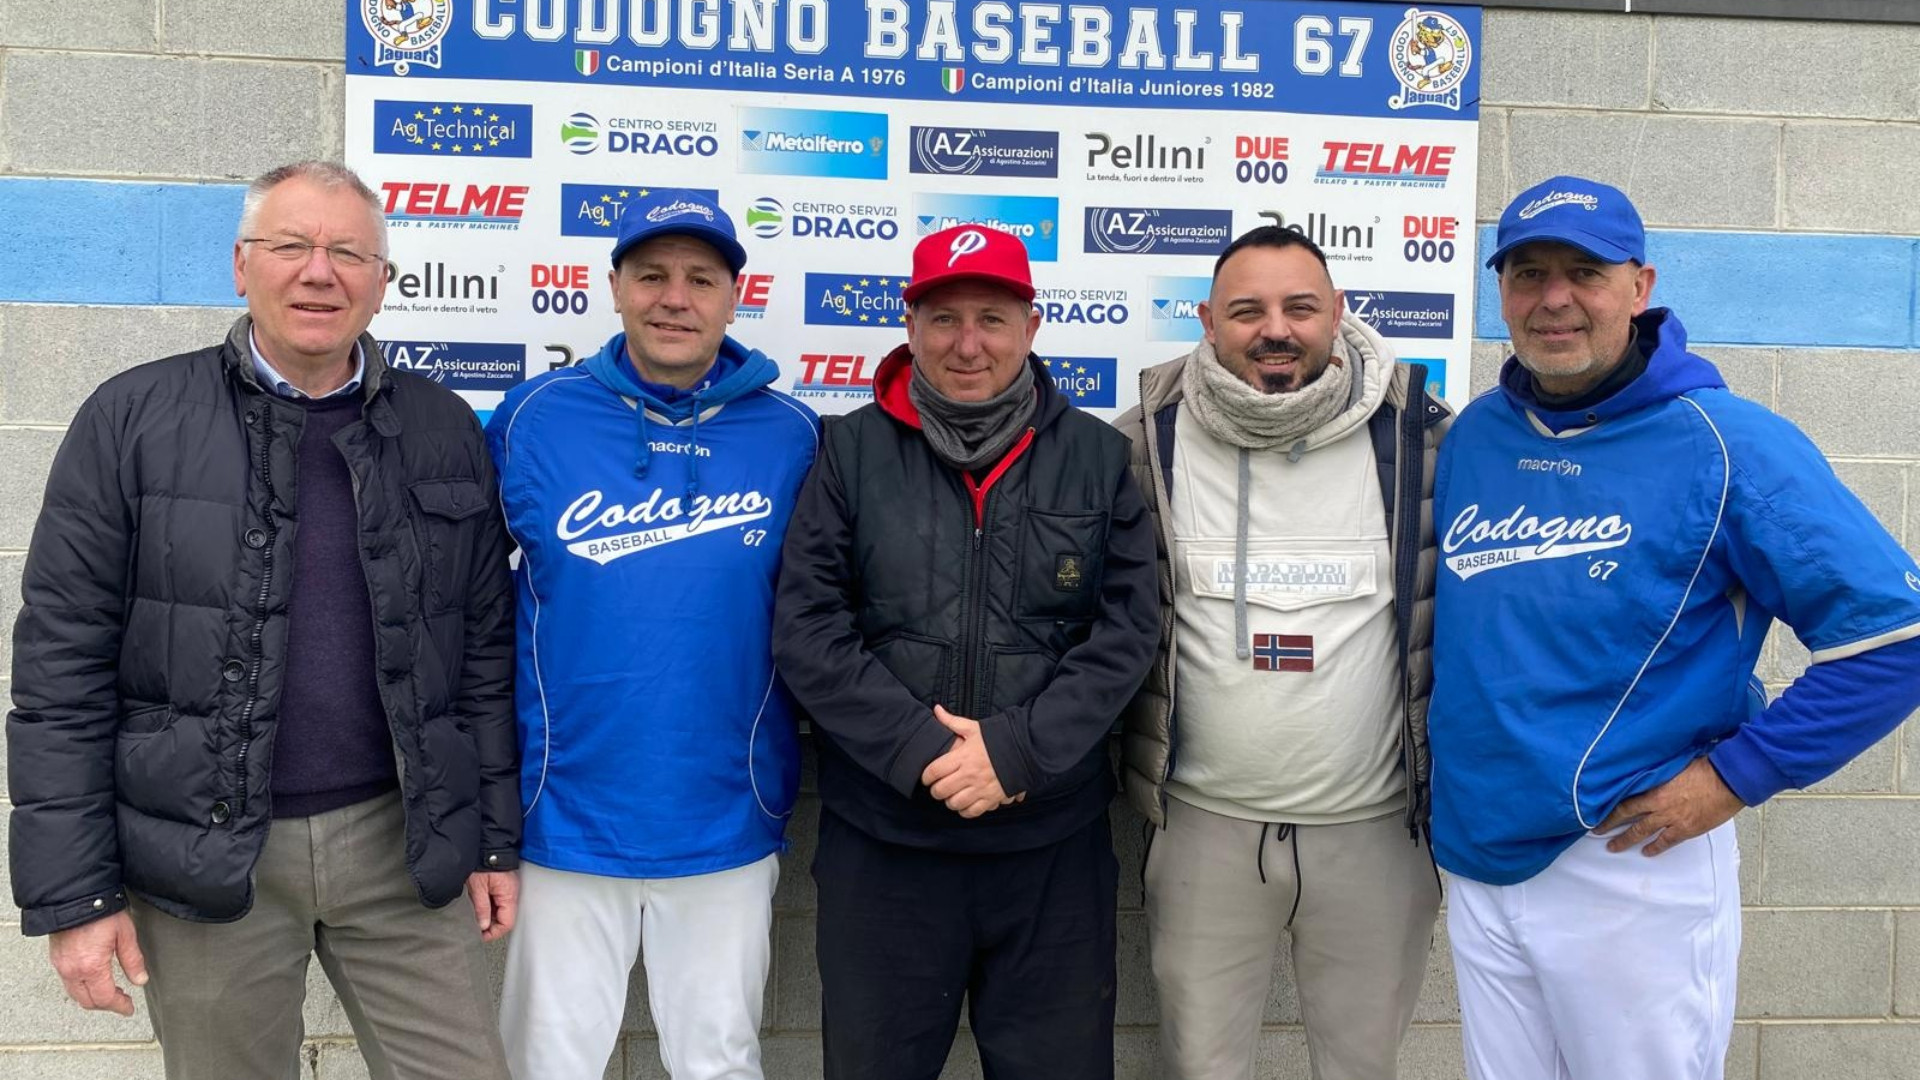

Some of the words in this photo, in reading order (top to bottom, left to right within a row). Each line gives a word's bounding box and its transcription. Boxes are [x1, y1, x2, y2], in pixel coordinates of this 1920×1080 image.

[368, 0, 391, 38] DOGNO
[472, 0, 829, 55] CODOGNO
[863, 0, 1260, 73] BASEBALL
[1293, 15, 1373, 77] 67
[1395, 30, 1416, 82] CODOGNO
[1432, 47, 1466, 89] BASEBALL
[606, 55, 703, 78] Campioni
[709, 60, 777, 79] d'Italia
[783, 63, 835, 82] Seria
[840, 66, 855, 83] A
[861, 67, 906, 86] 1976
[971, 72, 1063, 95] Campioni
[1069, 77, 1134, 96] d'Italia
[1139, 79, 1224, 98] Juniores
[1231, 81, 1275, 99] 1982
[391, 117, 418, 141] Ag
[424, 119, 515, 141] Technical
[608, 118, 663, 131] CENTRO
[666, 120, 717, 133] SERVIZI
[608, 131, 719, 157] DRAGO
[766, 132, 864, 154] Metalferro
[932, 132, 972, 156] AZ
[972, 145, 1053, 159] Assicurazioni
[1085, 133, 1204, 170] Pellini
[1235, 136, 1289, 160] DUE
[1322, 141, 1456, 176] TELME
[1086, 173, 1096, 181] La
[1123, 173, 1142, 182] fuori
[1150, 174, 1176, 183] dentro
[1177, 174, 1183, 183] il
[1184, 175, 1204, 183] vetro
[1313, 178, 1347, 186] GELATO
[1364, 179, 1397, 188] PASTRY
[1399, 180, 1446, 189] MACHINES
[381, 182, 530, 217] TELME
[578, 200, 605, 223] Ag
[792, 202, 846, 214] CENTRO
[849, 204, 897, 217] SERVIZI
[428, 222, 465, 230] PASTRY
[468, 223, 519, 231] MACHINES
[792, 216, 898, 241] DRAGO
[1106, 212, 1146, 235] AZ
[1146, 224, 1227, 237] Assicurazioni
[1403, 216, 1456, 239] DUE
[531, 264, 589, 289] DUE
[821, 289, 846, 314] Ag
[851, 290, 907, 310] Techn
[1034, 288, 1077, 300] ENTRO
[1080, 289, 1128, 301] SERVIZI
[412, 303, 432, 312] fuori
[440, 304, 468, 313] dentro
[469, 304, 475, 313] il
[476, 306, 498, 314] vetro
[1371, 306, 1449, 320] Assicurazioni
[391, 346, 433, 370] AZ
[434, 358, 521, 372] Assicurazioni
[556, 488, 772, 541] Codogno
[1443, 504, 1632, 553] Codogno
[588, 529, 673, 556] BASEBALL
[1457, 549, 1521, 571] BASEBALL
